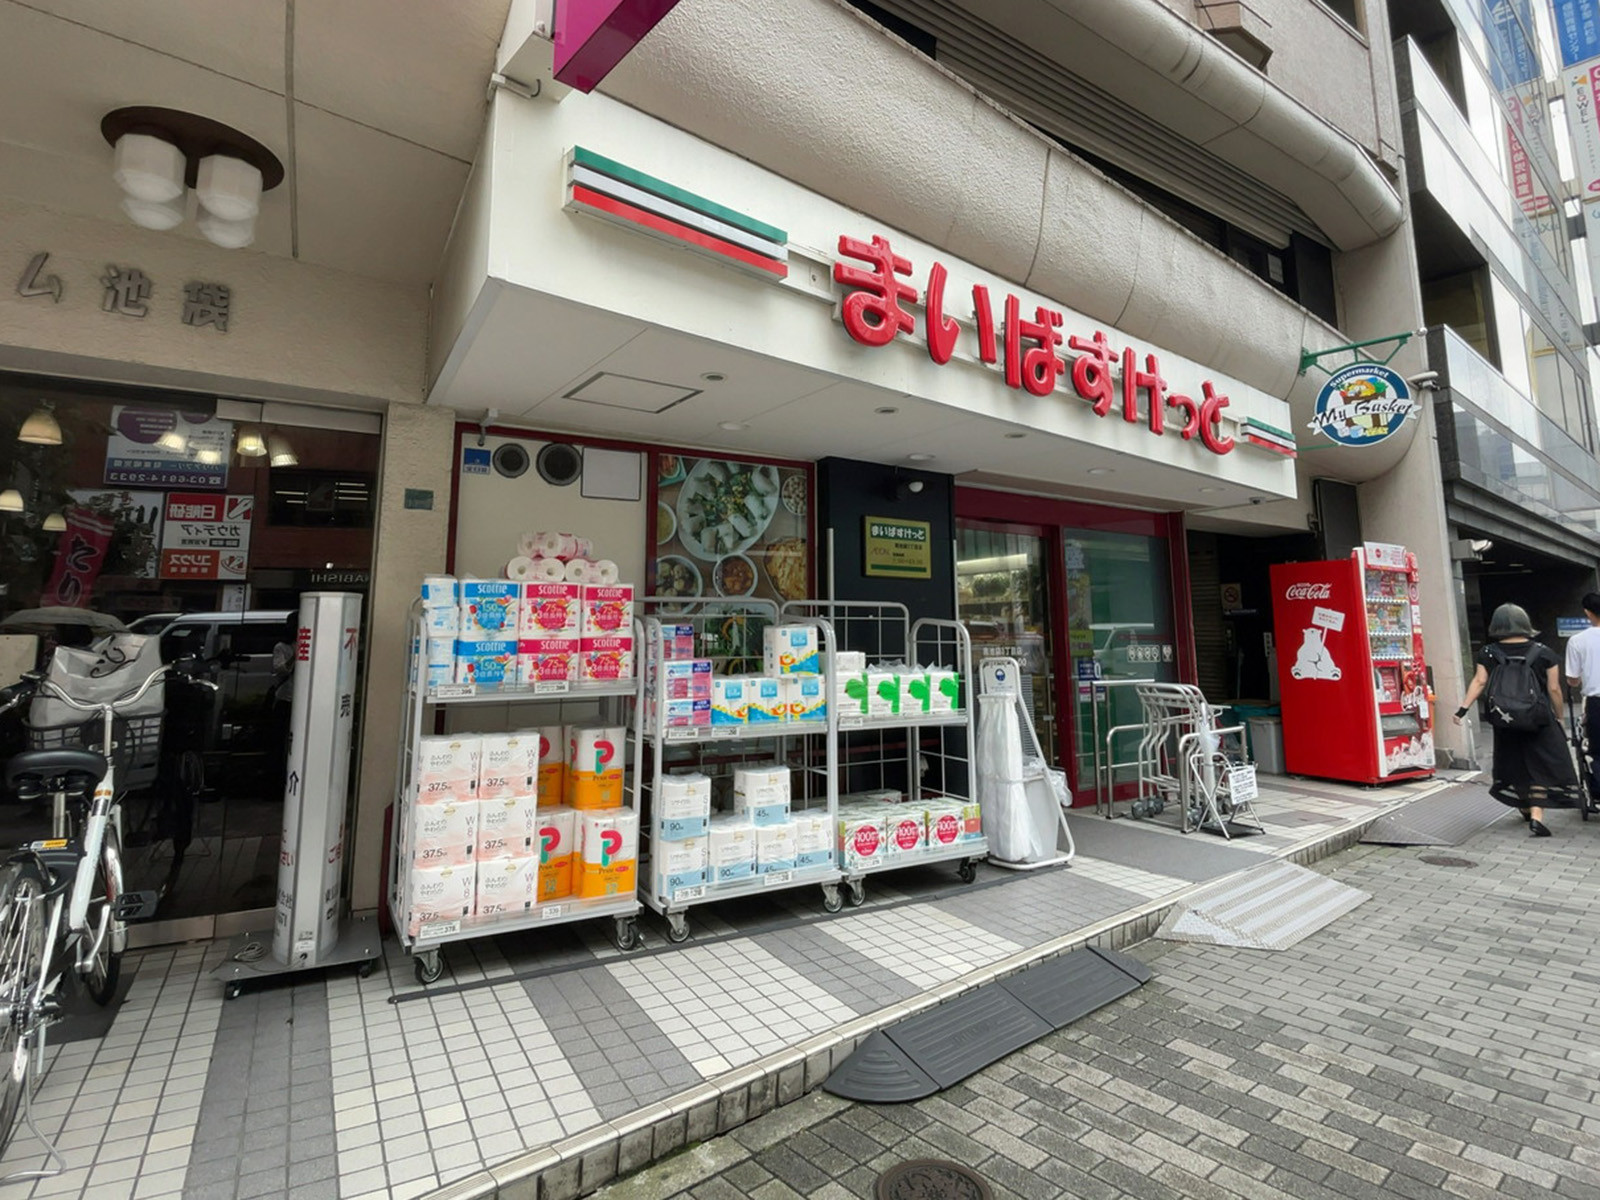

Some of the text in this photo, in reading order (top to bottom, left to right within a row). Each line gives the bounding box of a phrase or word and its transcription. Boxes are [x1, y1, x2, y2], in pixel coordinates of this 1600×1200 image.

[833, 233, 1236, 455] まいばすけっと
[1329, 367, 1390, 387] Supermarket
[1312, 398, 1413, 425] My Basket
[871, 524, 925, 540] まいばすけっと
[477, 584, 508, 594] scottie
[538, 584, 568, 595] scottie
[597, 588, 624, 598] scottie
[1285, 583, 1332, 601] Coca-Cola
[475, 642, 507, 652] scottie
[541, 640, 570, 650] scottie
[592, 638, 622, 648] scottie
